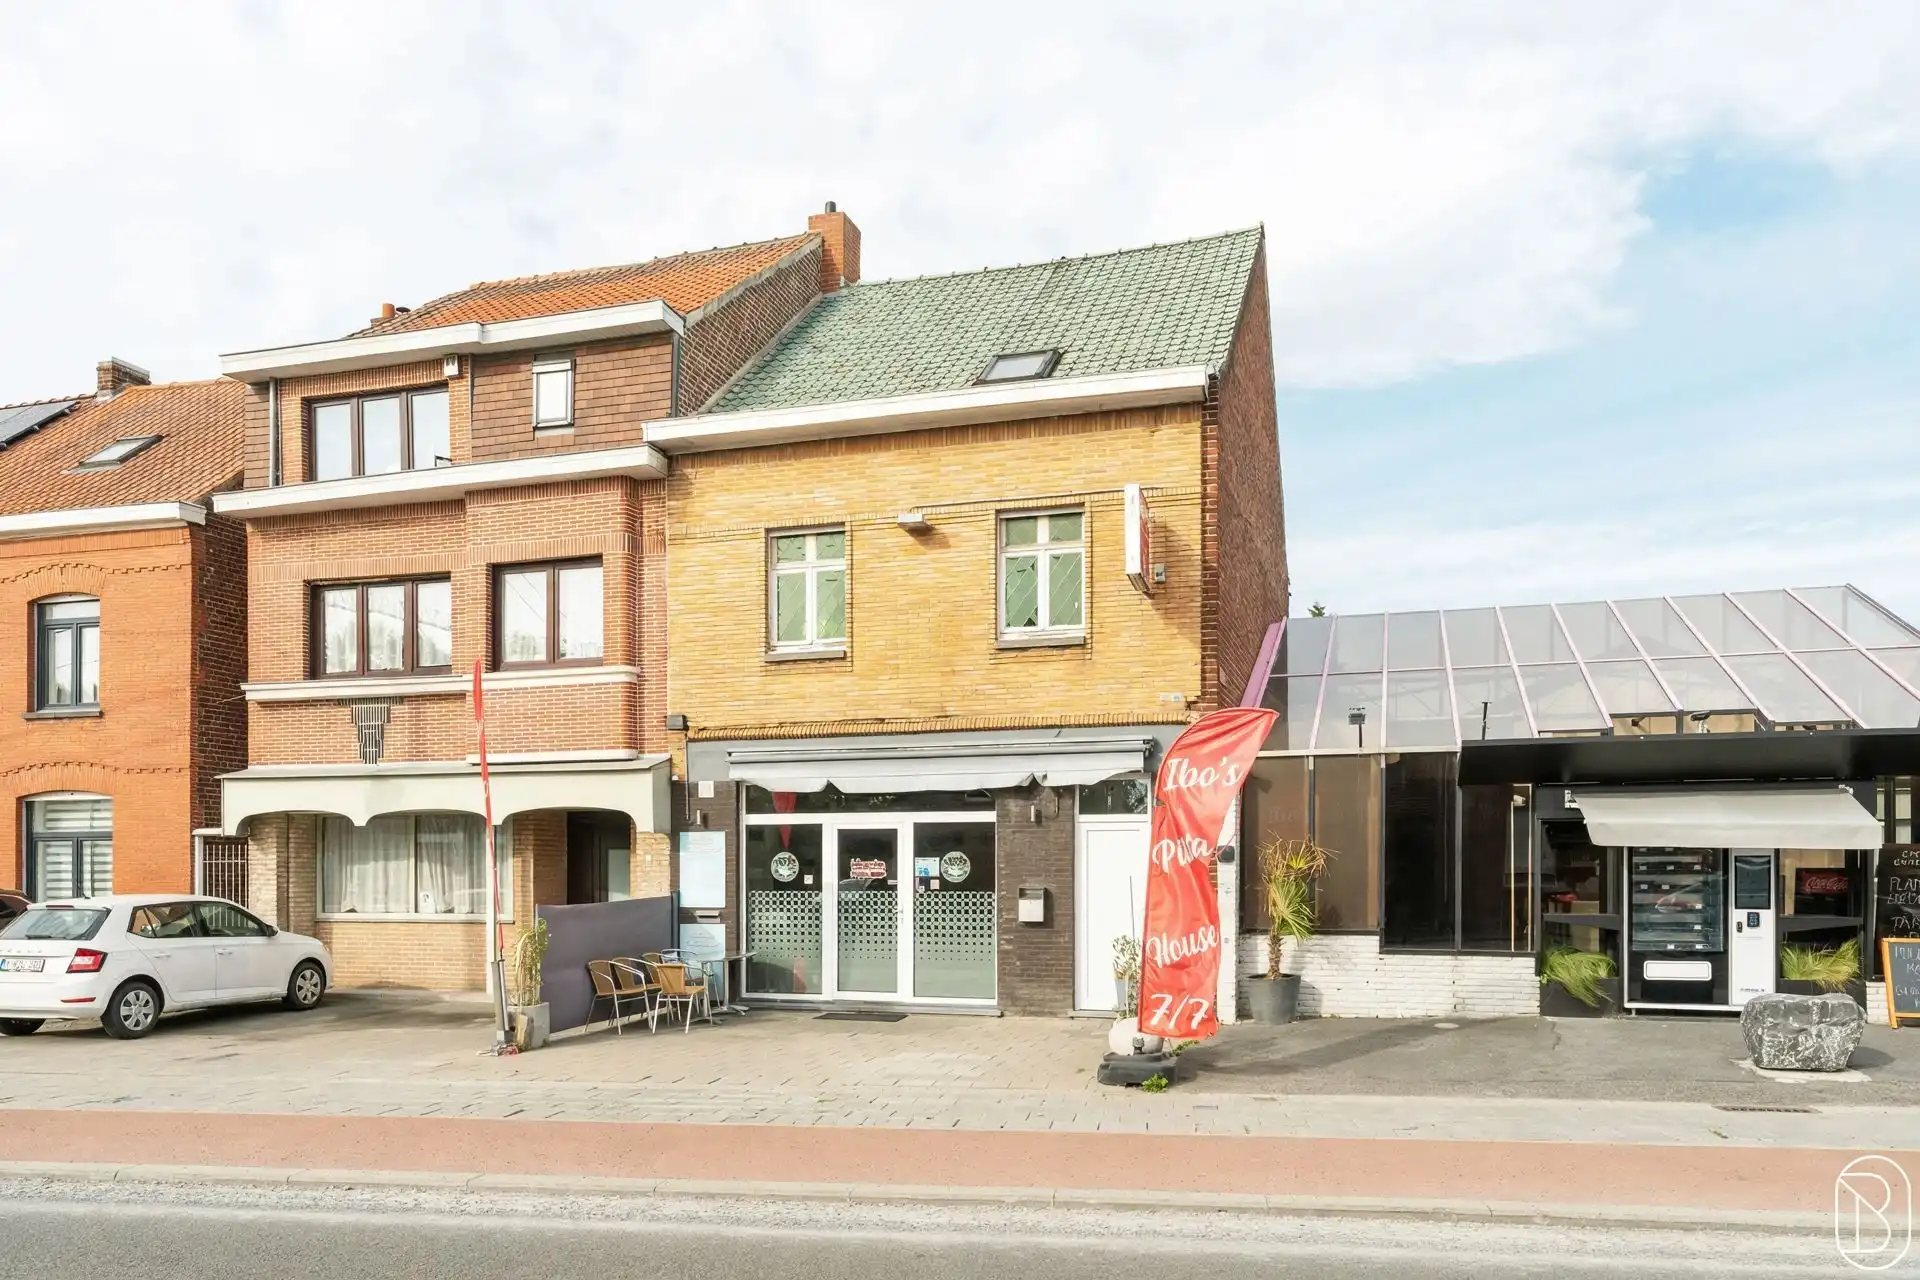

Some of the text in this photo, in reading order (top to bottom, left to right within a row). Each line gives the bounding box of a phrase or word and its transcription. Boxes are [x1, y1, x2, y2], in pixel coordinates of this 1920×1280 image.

[1163, 756, 1243, 791] Ibo's
[1146, 925, 1219, 968] House
[1150, 992, 1209, 1030] 7/7
